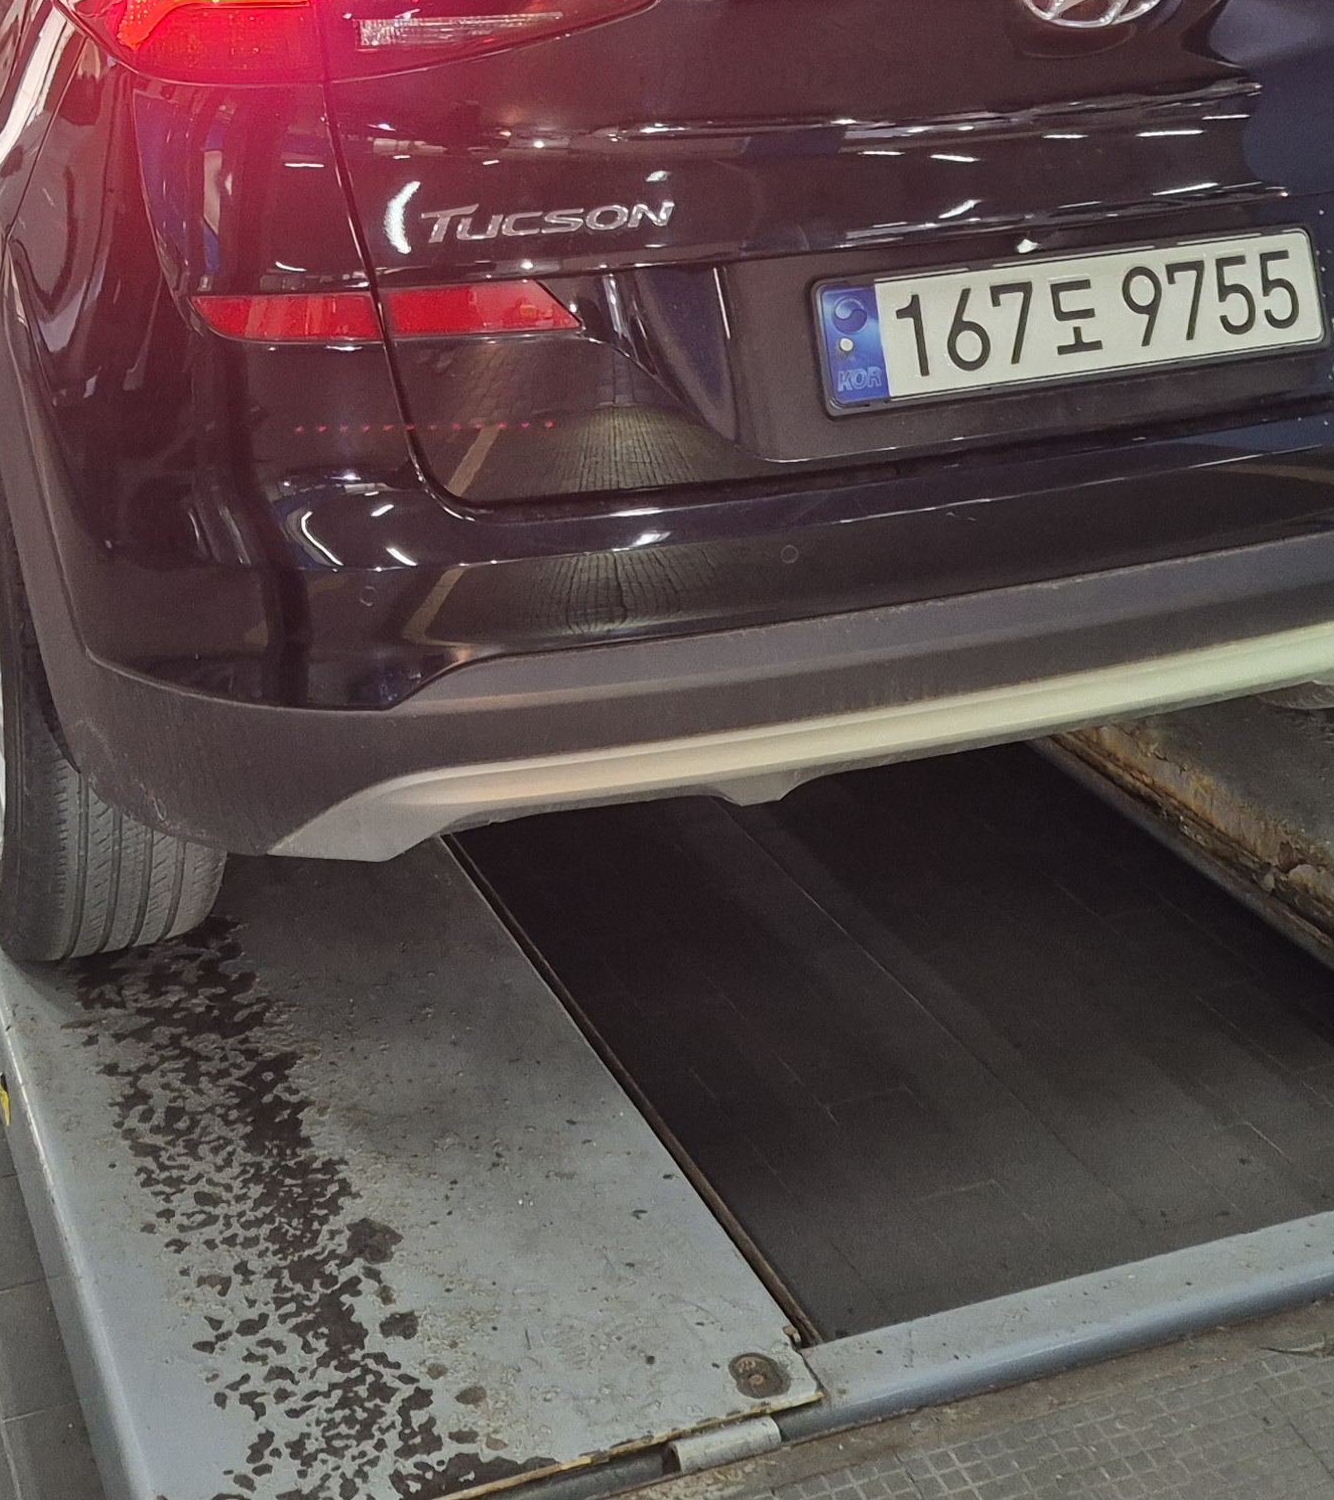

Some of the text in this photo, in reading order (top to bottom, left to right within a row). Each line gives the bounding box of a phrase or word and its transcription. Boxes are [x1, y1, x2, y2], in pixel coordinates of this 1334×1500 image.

[420, 200, 675, 244] TUCSON
[895, 249, 1300, 377] 167도 9755
[836, 365, 882, 393] KOR
